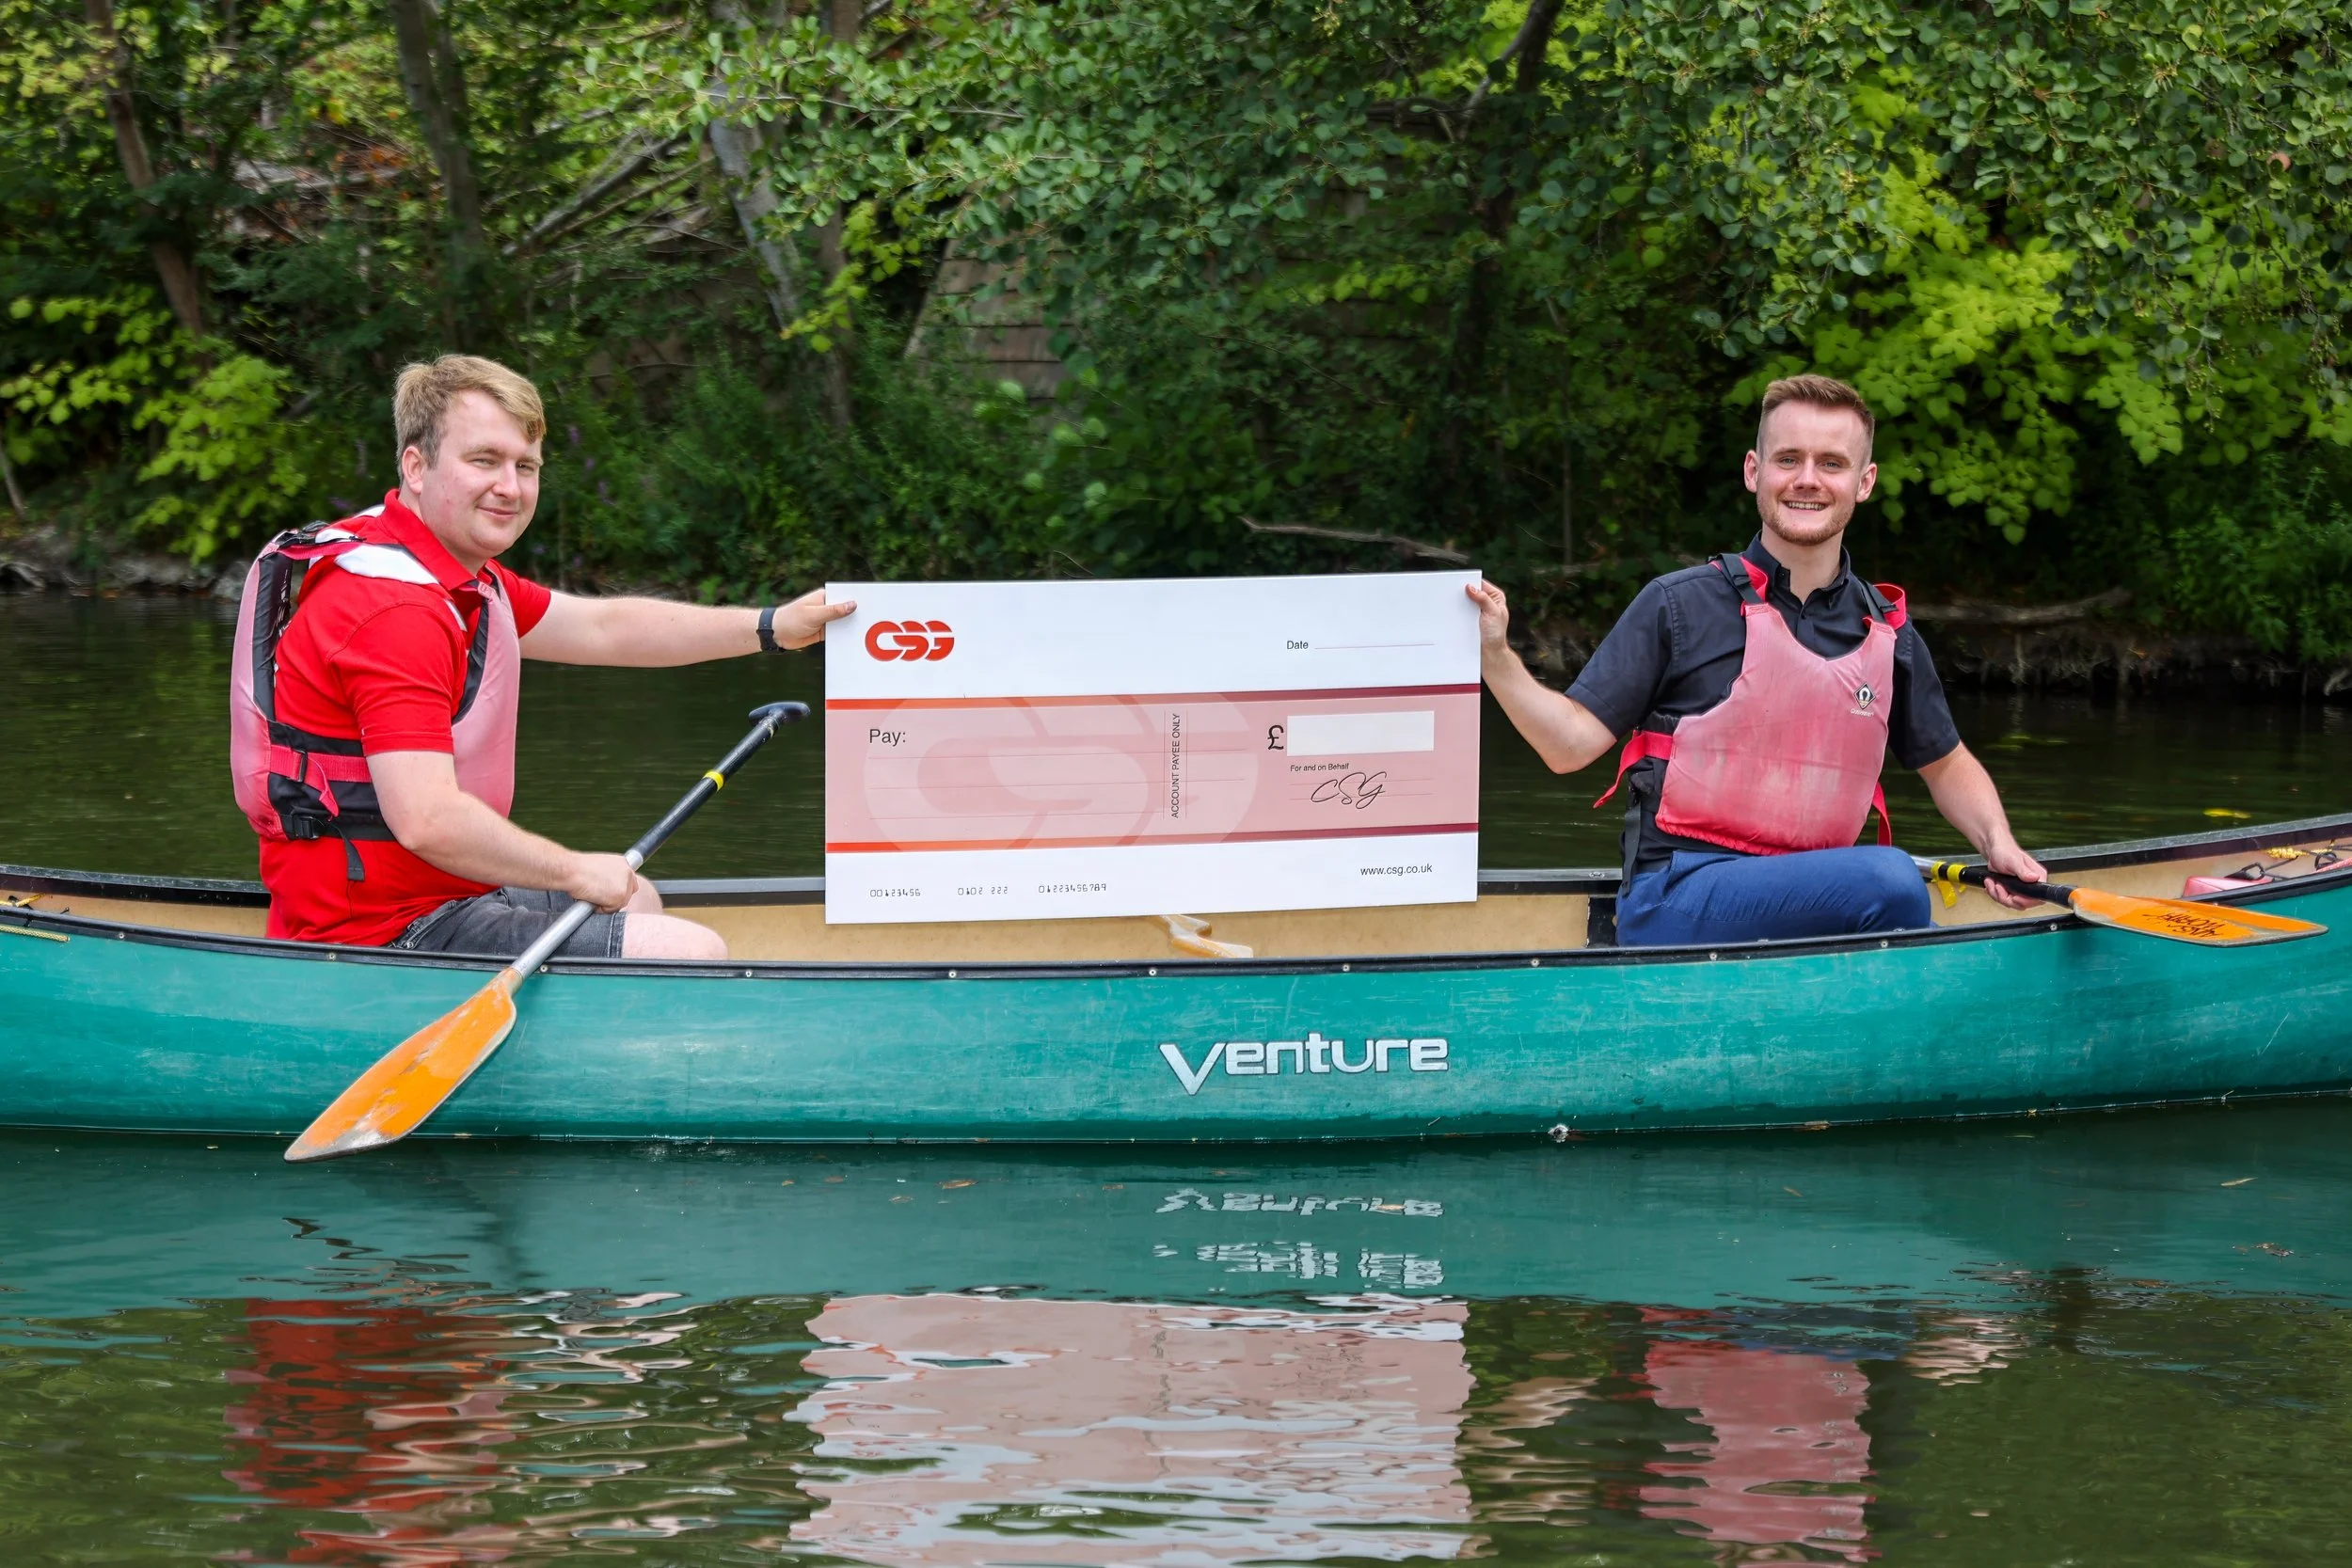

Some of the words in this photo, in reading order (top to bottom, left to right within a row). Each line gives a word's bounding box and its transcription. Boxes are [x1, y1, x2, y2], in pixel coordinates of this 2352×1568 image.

[864, 620, 955, 662] CSG
[1286, 640, 1309, 650] Date
[868, 729, 906, 747] Pay:
[1171, 713, 1181, 738] ONLY
[1267, 724, 1284, 751] £
[1171, 740, 1181, 770] PAYEE
[1290, 764, 1302, 772] For
[1327, 762, 1350, 770] Behalf
[1170, 772, 1181, 819] ACCOUNT
[1359, 863, 1433, 876] www.csg.co.uk
[869, 888, 921, 897] 00123456
[1159, 1031, 1449, 1096] Venture
